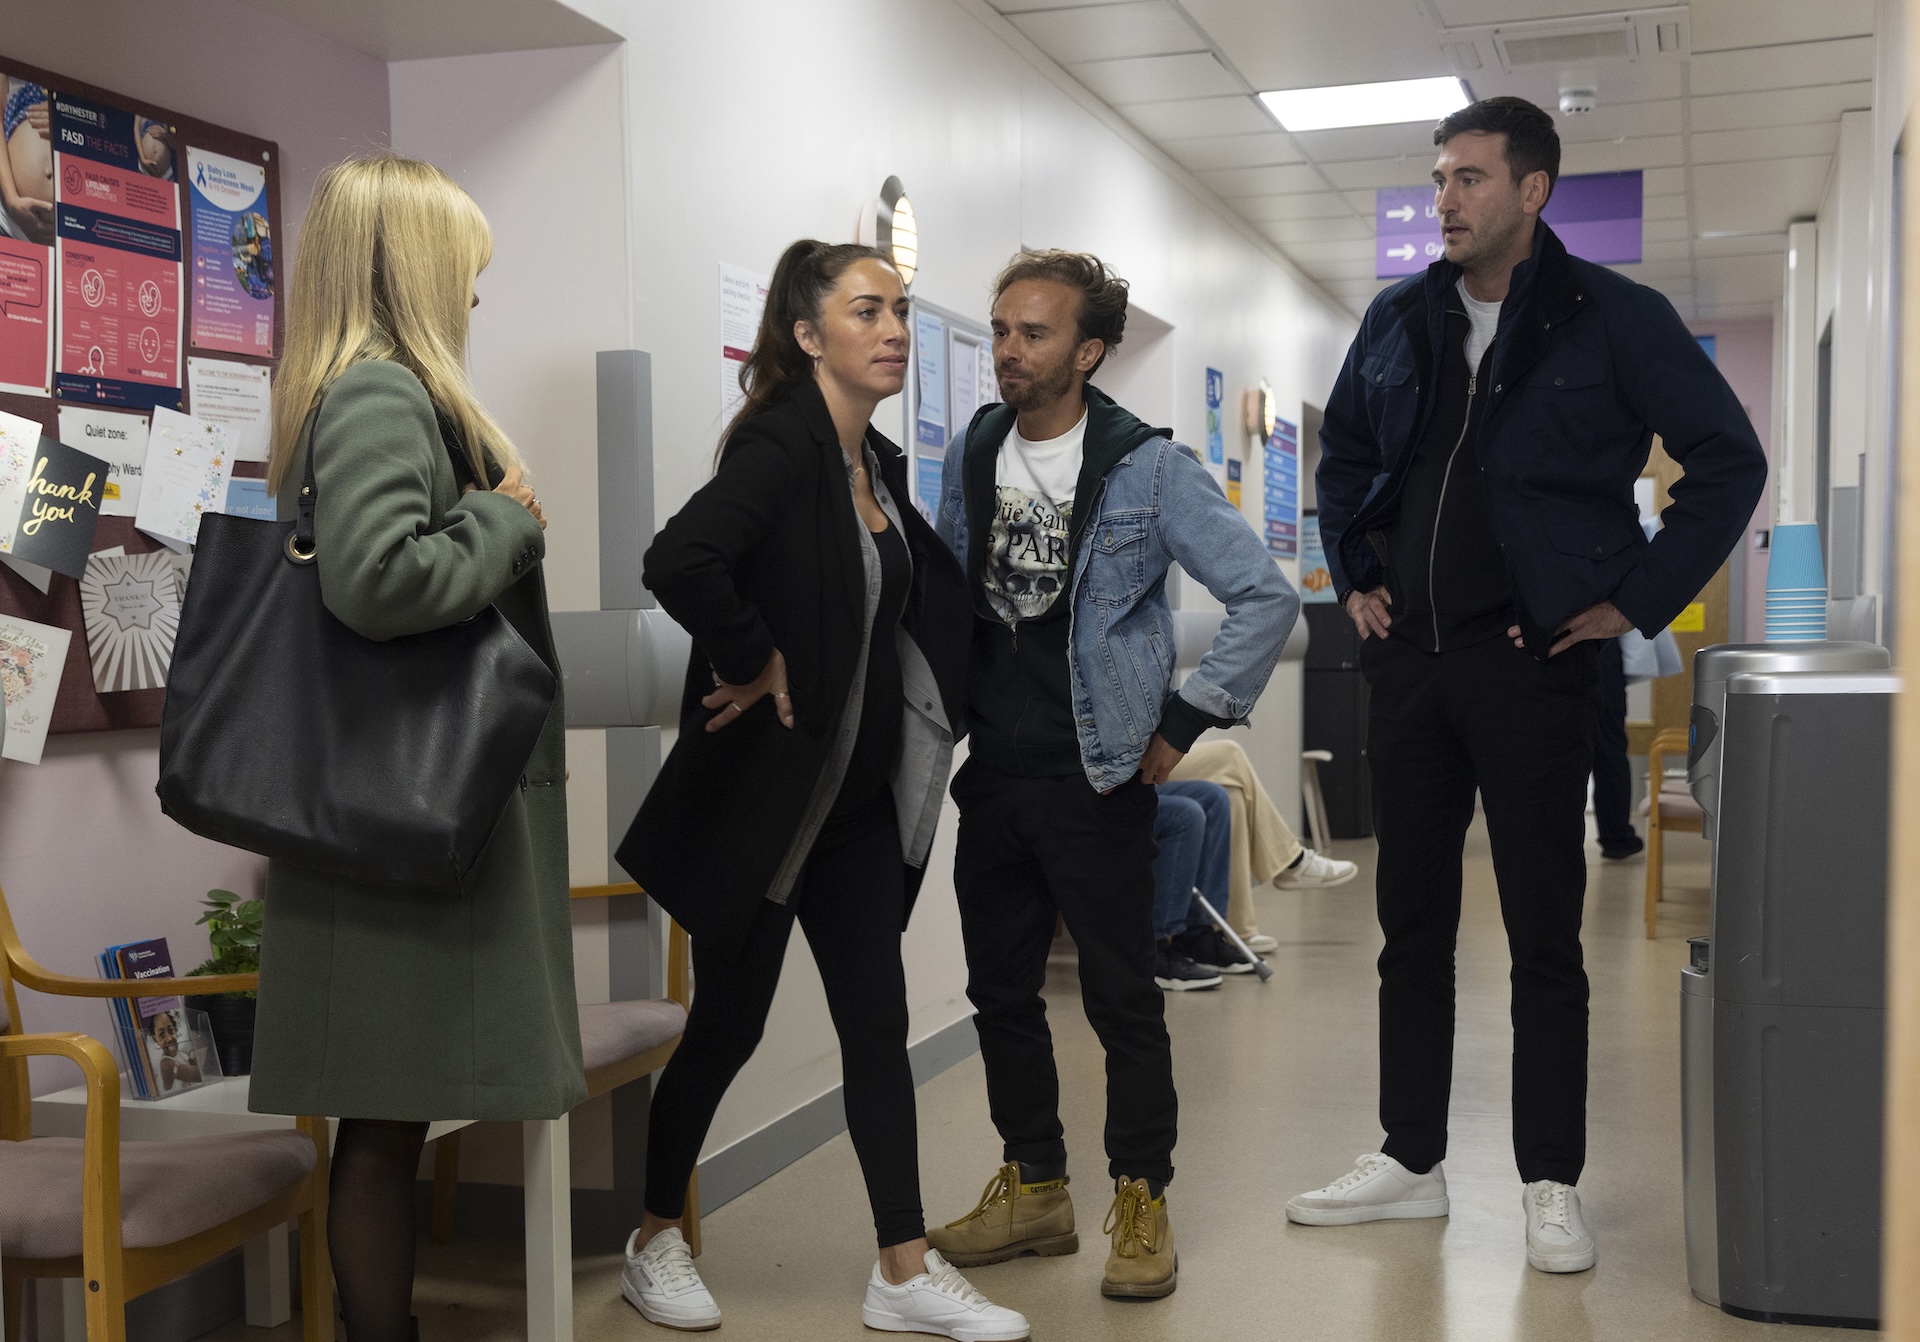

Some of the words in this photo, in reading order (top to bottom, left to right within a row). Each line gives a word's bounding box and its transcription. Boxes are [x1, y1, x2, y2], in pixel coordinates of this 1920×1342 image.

[61, 128, 85, 146] FASD
[86, 135, 103, 151] THE
[103, 142, 129, 158] FACTS
[207, 164, 222, 177] Baby
[223, 170, 236, 179] Loss
[85, 180, 110, 193] LIFELONG
[208, 174, 240, 189] Awareness
[240, 182, 255, 193] Week
[1425, 205, 1439, 219] U
[66, 250, 95, 263] CONDITIONS
[1425, 242, 1446, 258] Gy
[722, 288, 736, 299] packing
[756, 284, 769, 297] Tom
[85, 424, 106, 439] Quiet
[107, 428, 128, 440] zone:
[108, 461, 121, 477] phy
[122, 462, 142, 476] Ward
[27, 456, 96, 509] hank
[23, 497, 74, 535] you
[225, 505, 235, 514] re
[236, 505, 249, 514] not
[250, 504, 273, 517] alone
[134, 965, 170, 979] Vaccination
